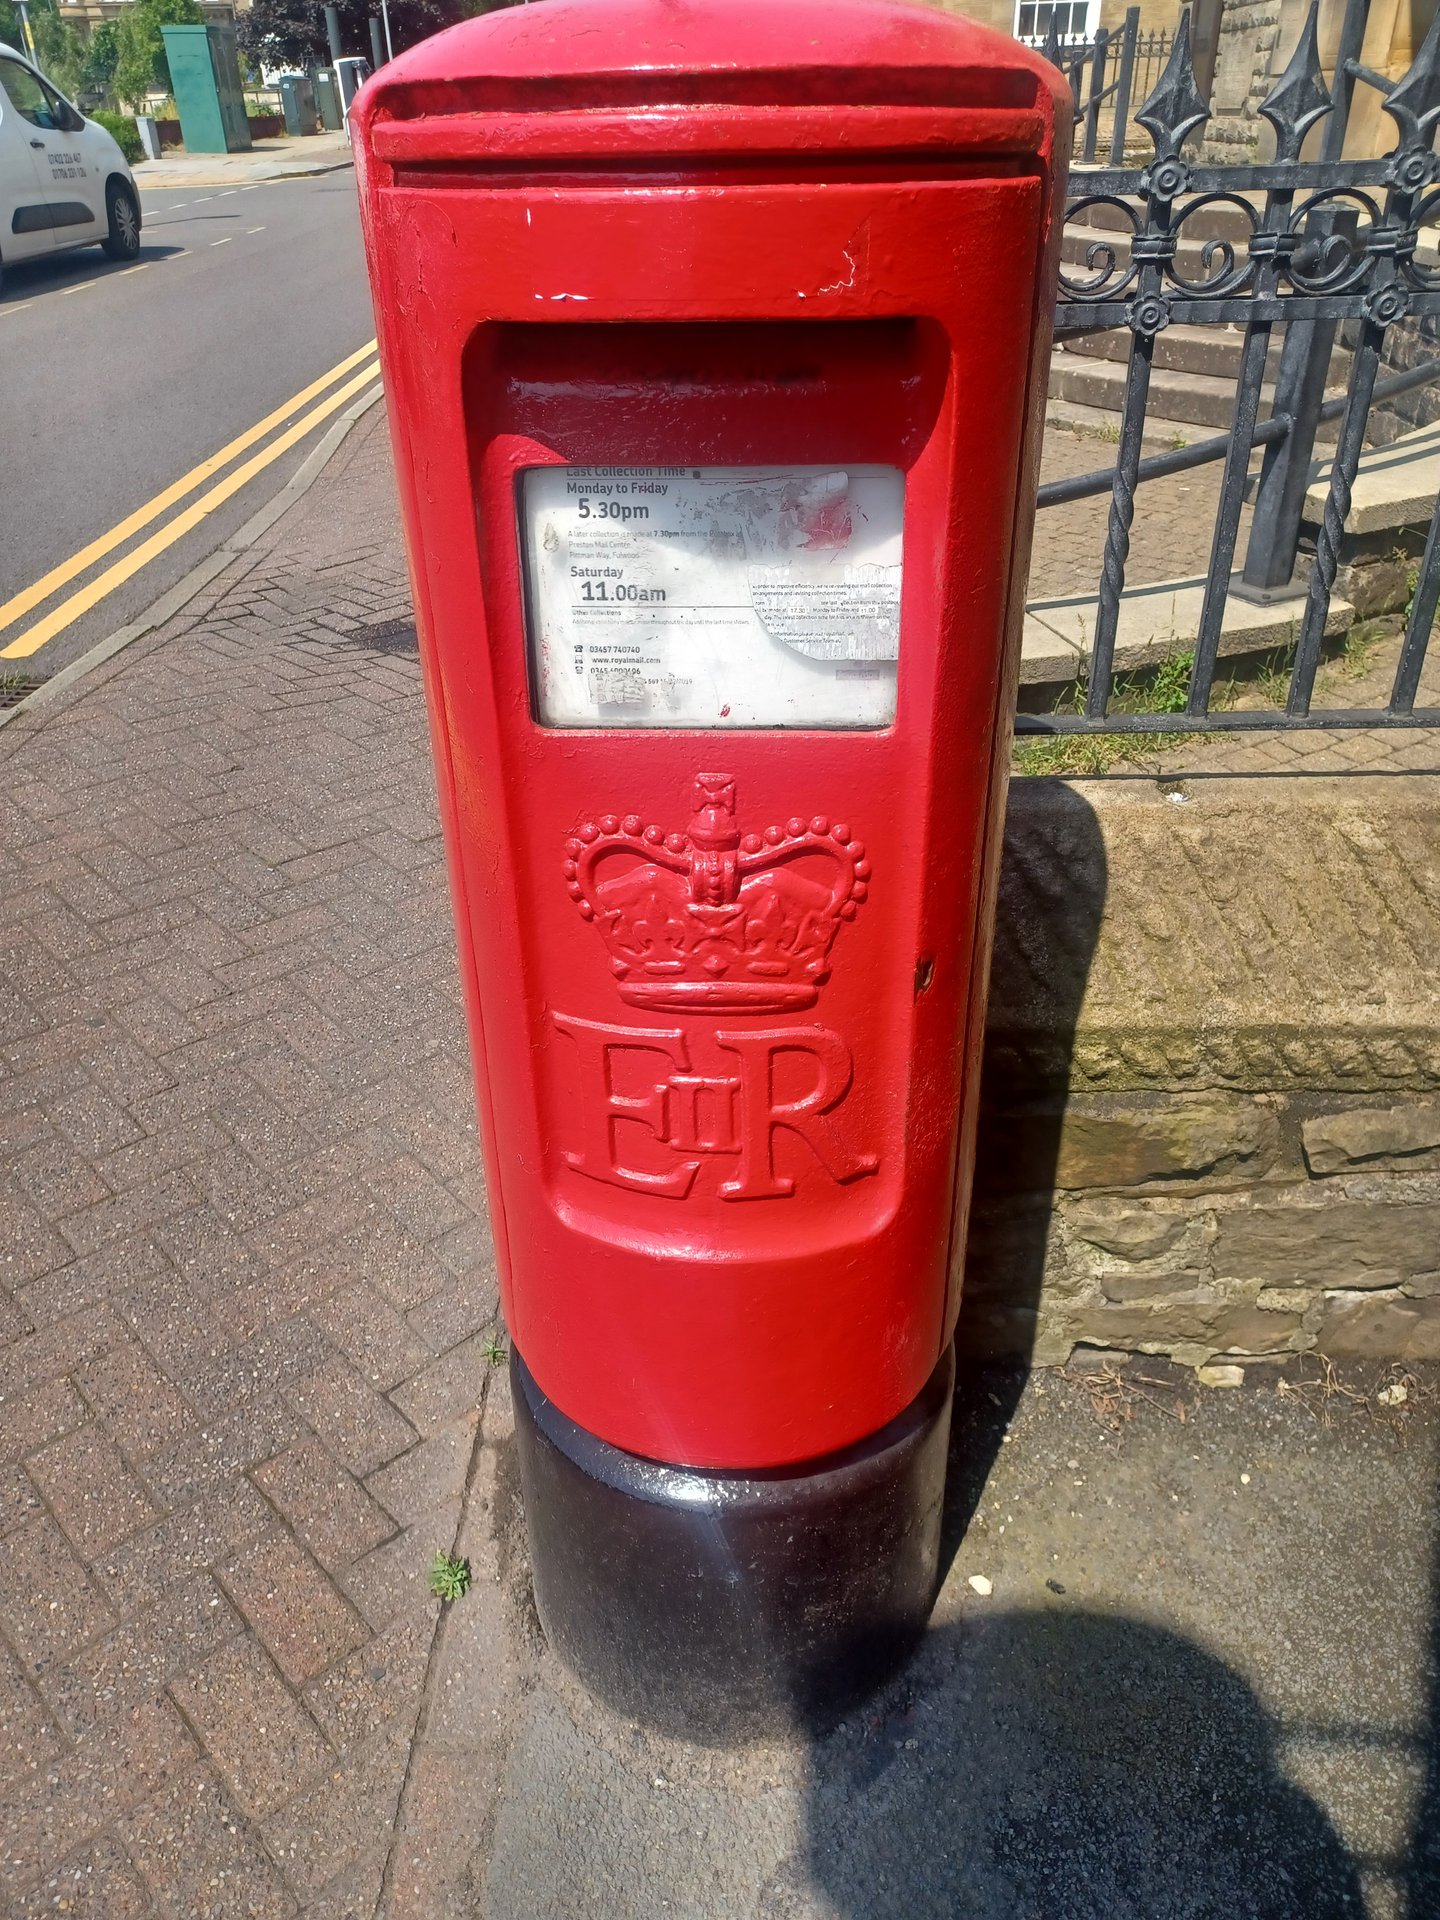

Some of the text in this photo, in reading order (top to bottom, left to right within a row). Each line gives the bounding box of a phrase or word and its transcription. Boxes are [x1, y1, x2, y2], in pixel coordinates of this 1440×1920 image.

[566, 467, 686, 477] Last Collection Time
[566, 482, 669, 496] Monday to Friday
[578, 497, 649, 522] 5.30pm
[574, 530, 588, 538] later
[589, 530, 619, 538] collection
[653, 530, 680, 538] 7.30pm
[680, 530, 696, 538] from
[570, 566, 624, 579] Saturday
[581, 581, 667, 601] 11.00am
[589, 645, 641, 654] 03457 740740
[591, 656, 661, 665] www.royalmail.com
